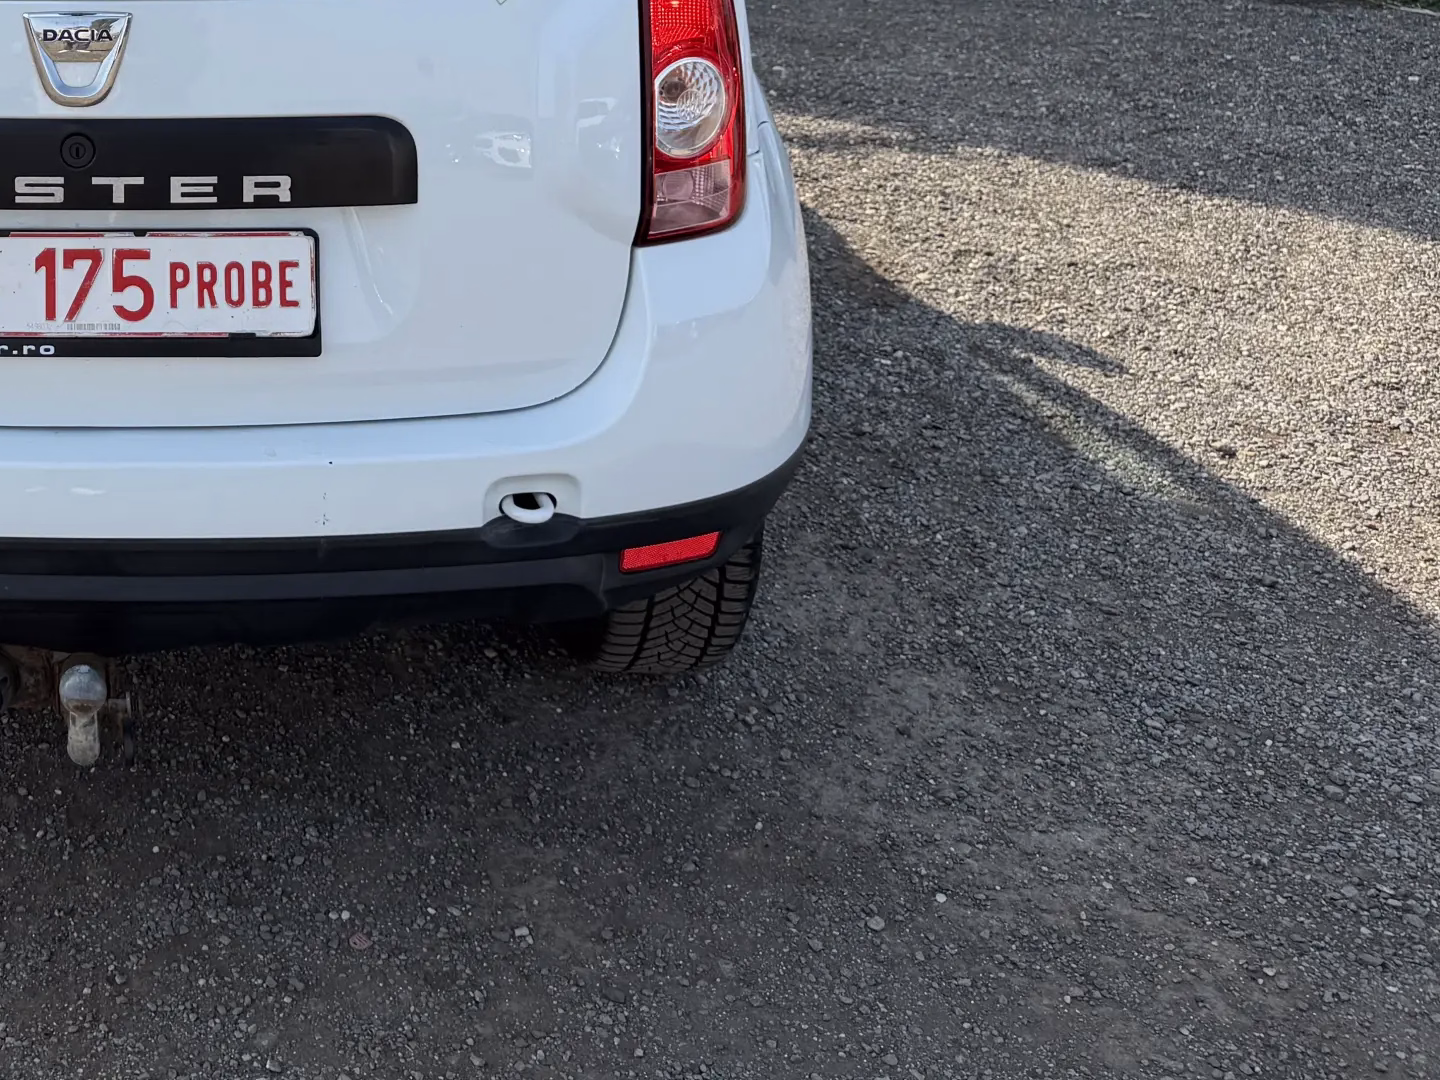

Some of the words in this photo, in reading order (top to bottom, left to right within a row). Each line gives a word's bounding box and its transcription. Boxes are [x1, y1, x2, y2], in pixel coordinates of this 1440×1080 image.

[42, 27, 113, 43] DACIA
[34, 246, 155, 323] 175
[169, 260, 301, 309] PROBE
